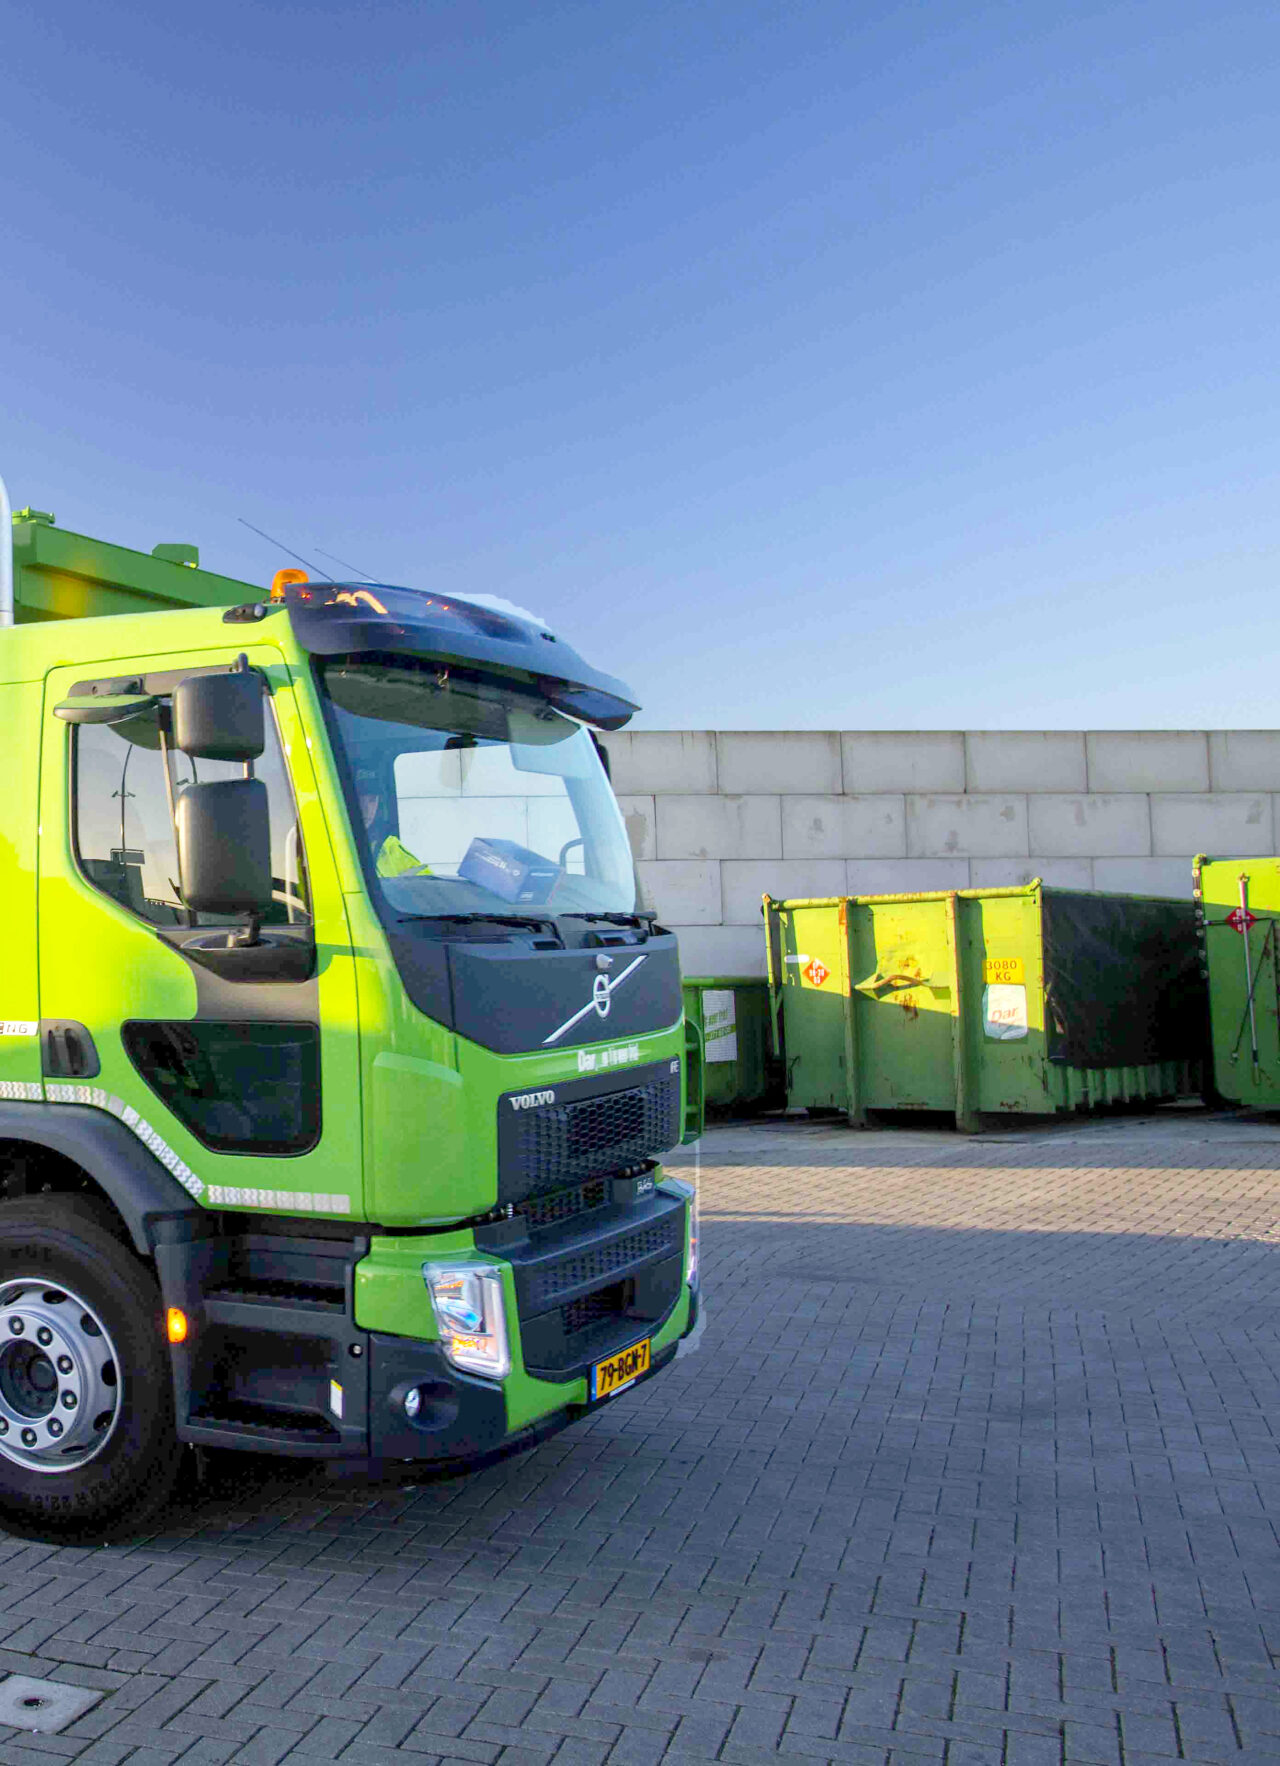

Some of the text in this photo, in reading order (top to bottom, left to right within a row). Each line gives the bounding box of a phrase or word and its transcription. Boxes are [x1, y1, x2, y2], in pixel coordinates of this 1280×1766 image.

[995, 972, 1011, 981] KG
[991, 1007, 1019, 1023] Dar
[509, 1090, 555, 1110] VOLVO
[600, 1344, 647, 1391] 79-BGN-7
